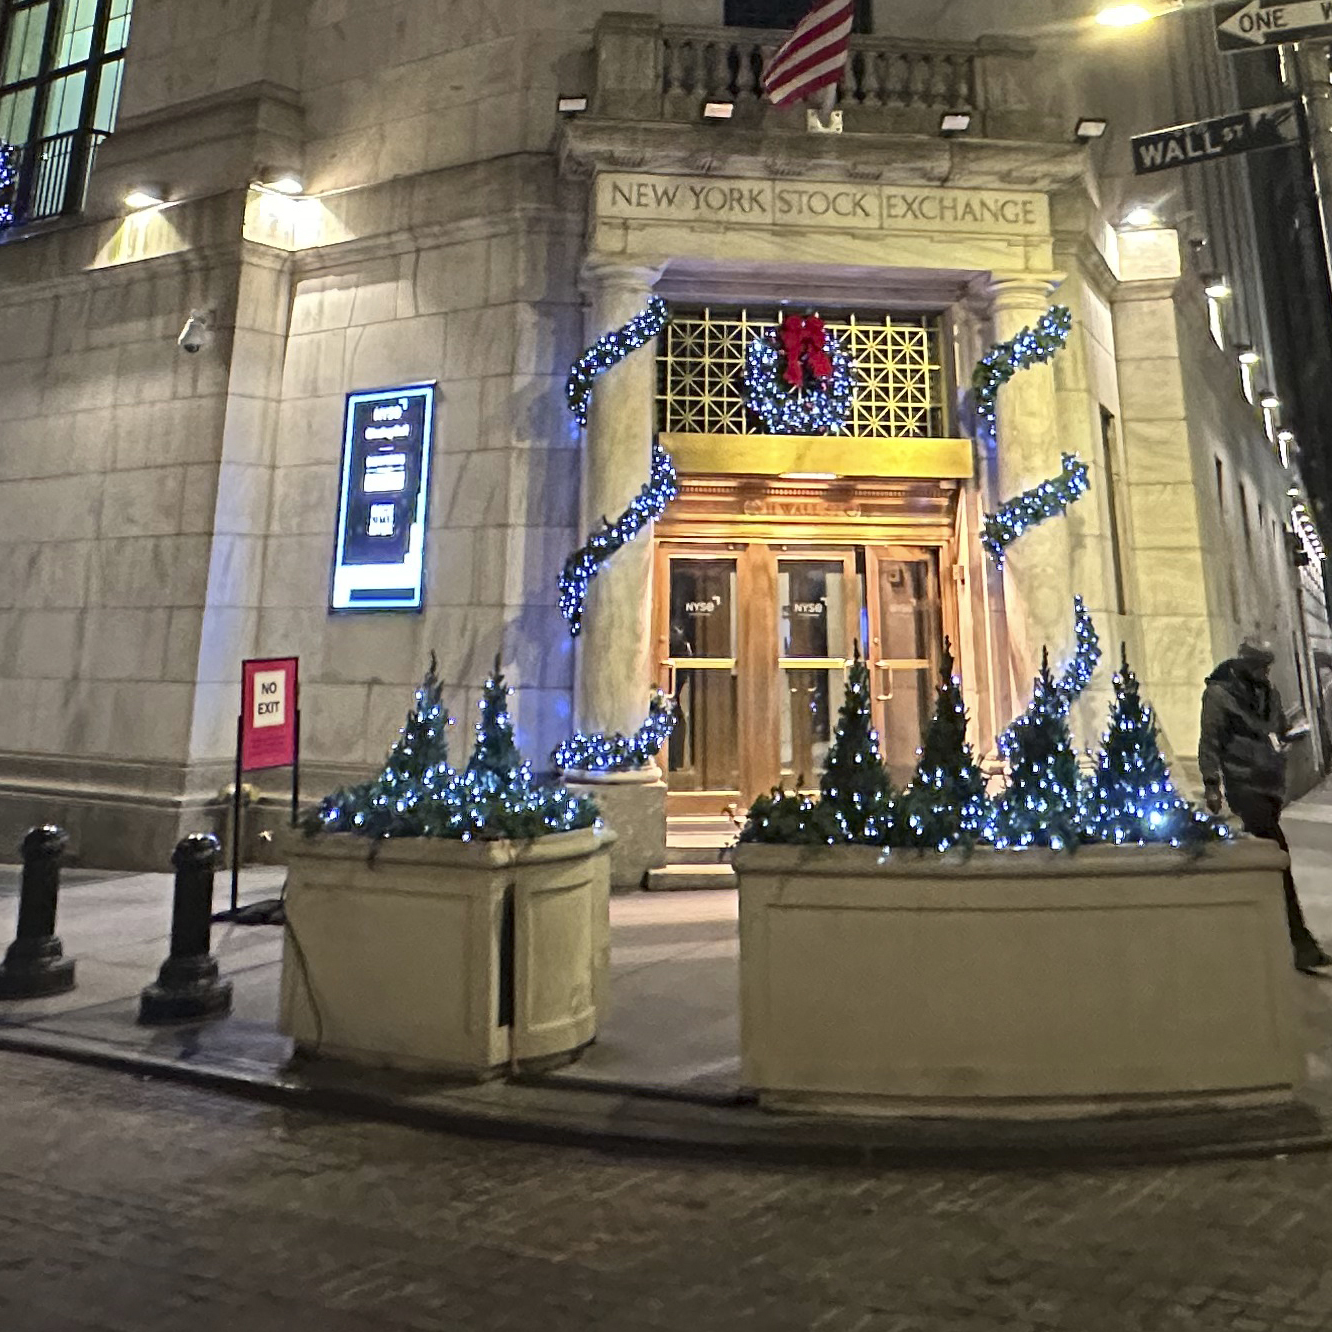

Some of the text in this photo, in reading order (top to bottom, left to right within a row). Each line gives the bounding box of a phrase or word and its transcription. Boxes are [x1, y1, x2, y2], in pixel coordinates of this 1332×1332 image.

[1238, 8, 1288, 33] ONE
[1139, 130, 1222, 168] WALL
[1221, 123, 1244, 142] ST
[611, 181, 1037, 225] NEW YORK STOCK EXCHANGE
[261, 682, 277, 695] NO
[258, 701, 280, 715] EXIT
